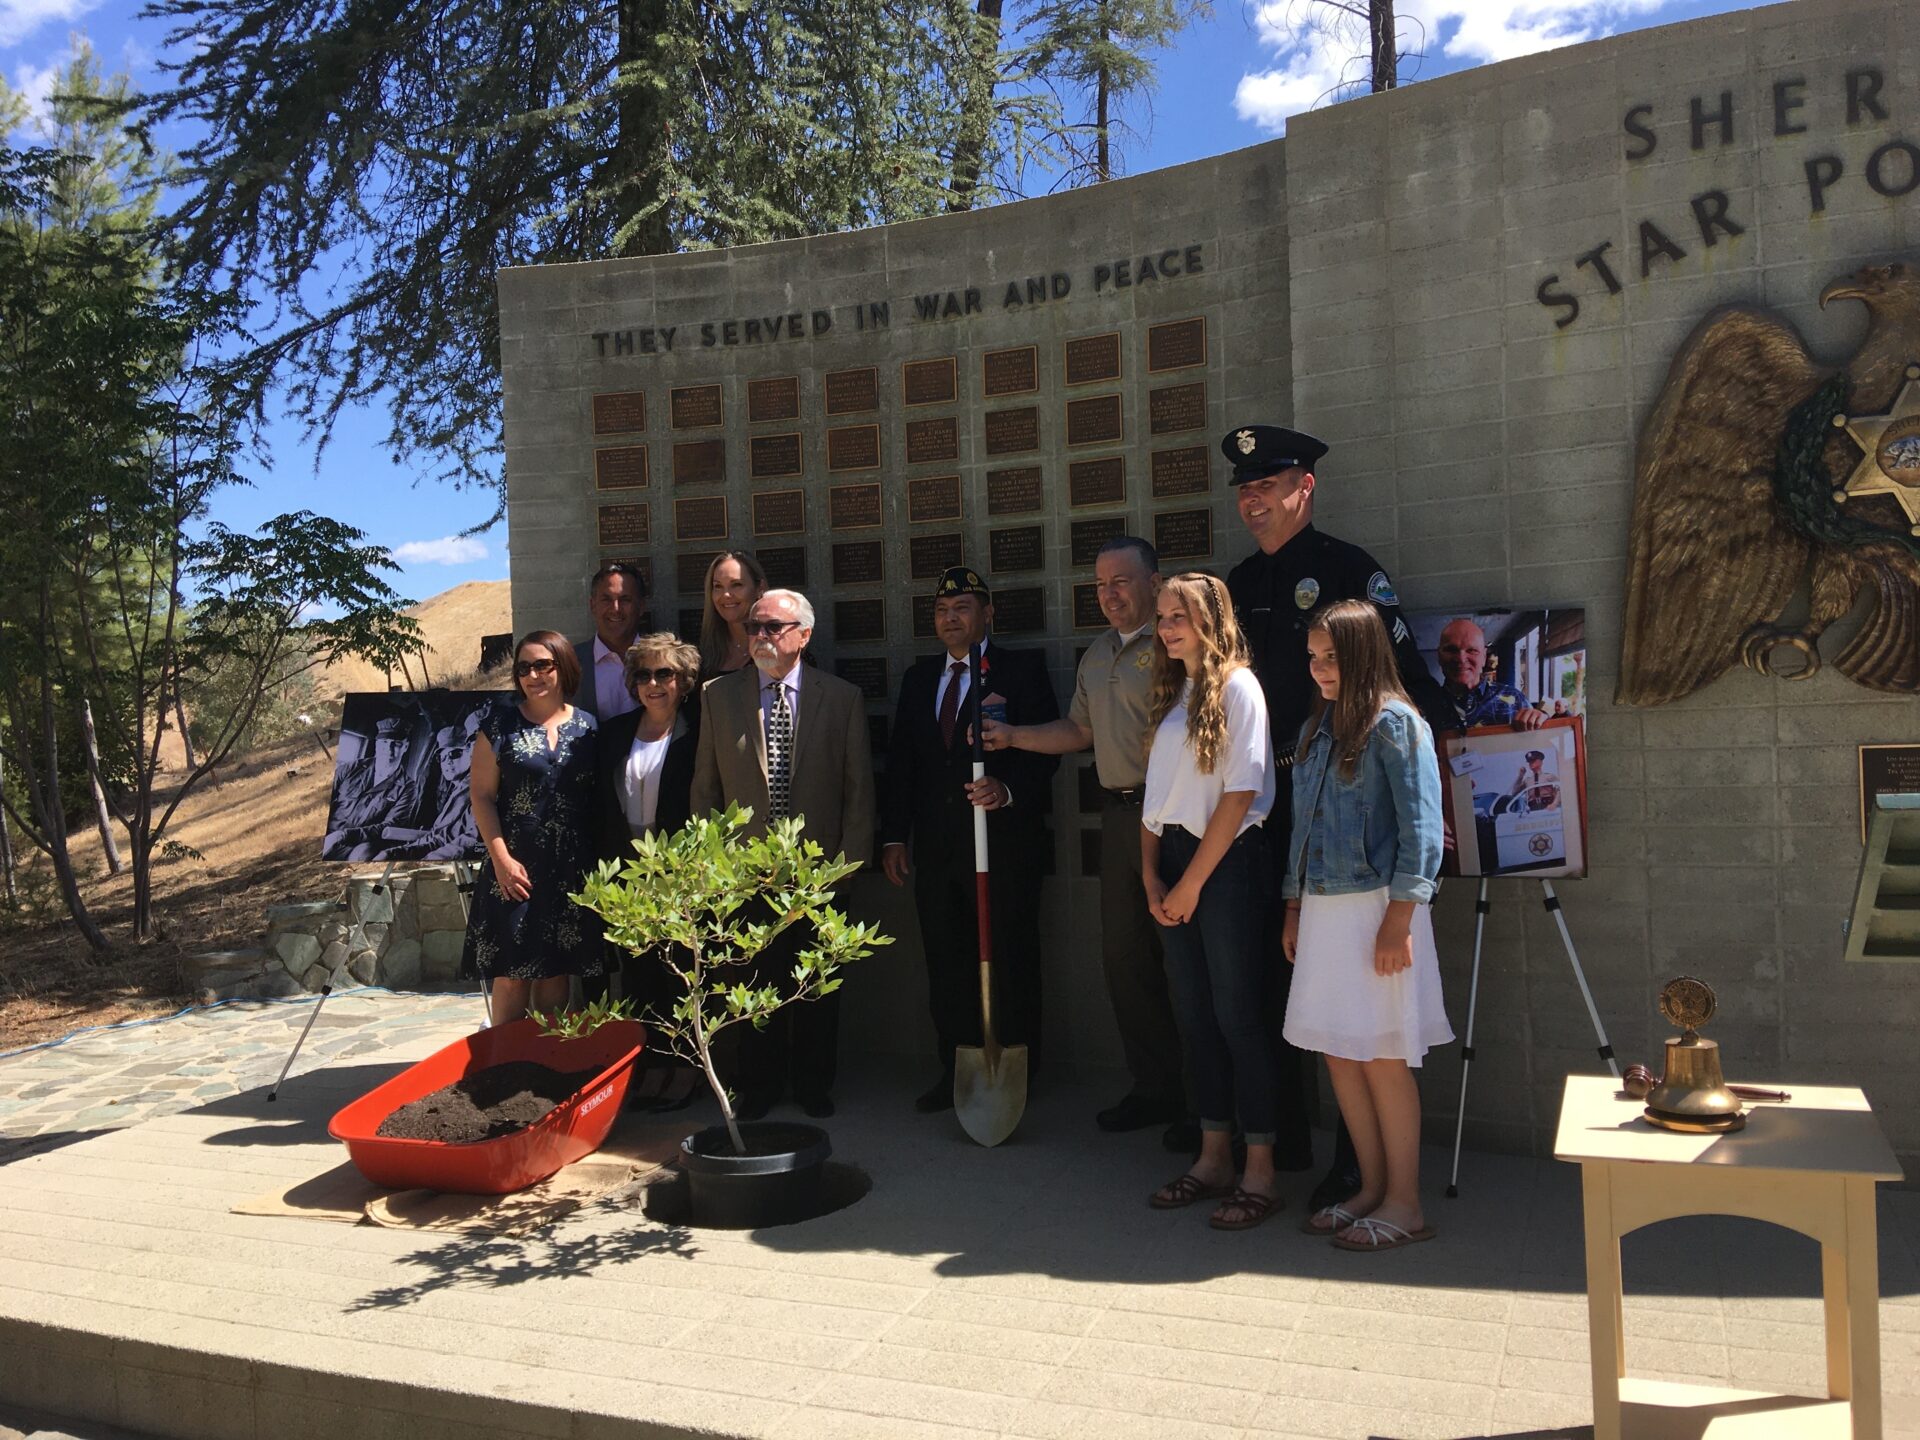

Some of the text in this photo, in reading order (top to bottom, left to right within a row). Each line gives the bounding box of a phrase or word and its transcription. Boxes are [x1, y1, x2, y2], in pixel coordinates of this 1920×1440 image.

[1624, 69, 1889, 160] SHER
[1537, 140, 1920, 329] STAR PO
[592, 244, 1205, 357] THEY SERVED IN WAR AND PEACE
[581, 1084, 614, 1118] SEYMOUR
